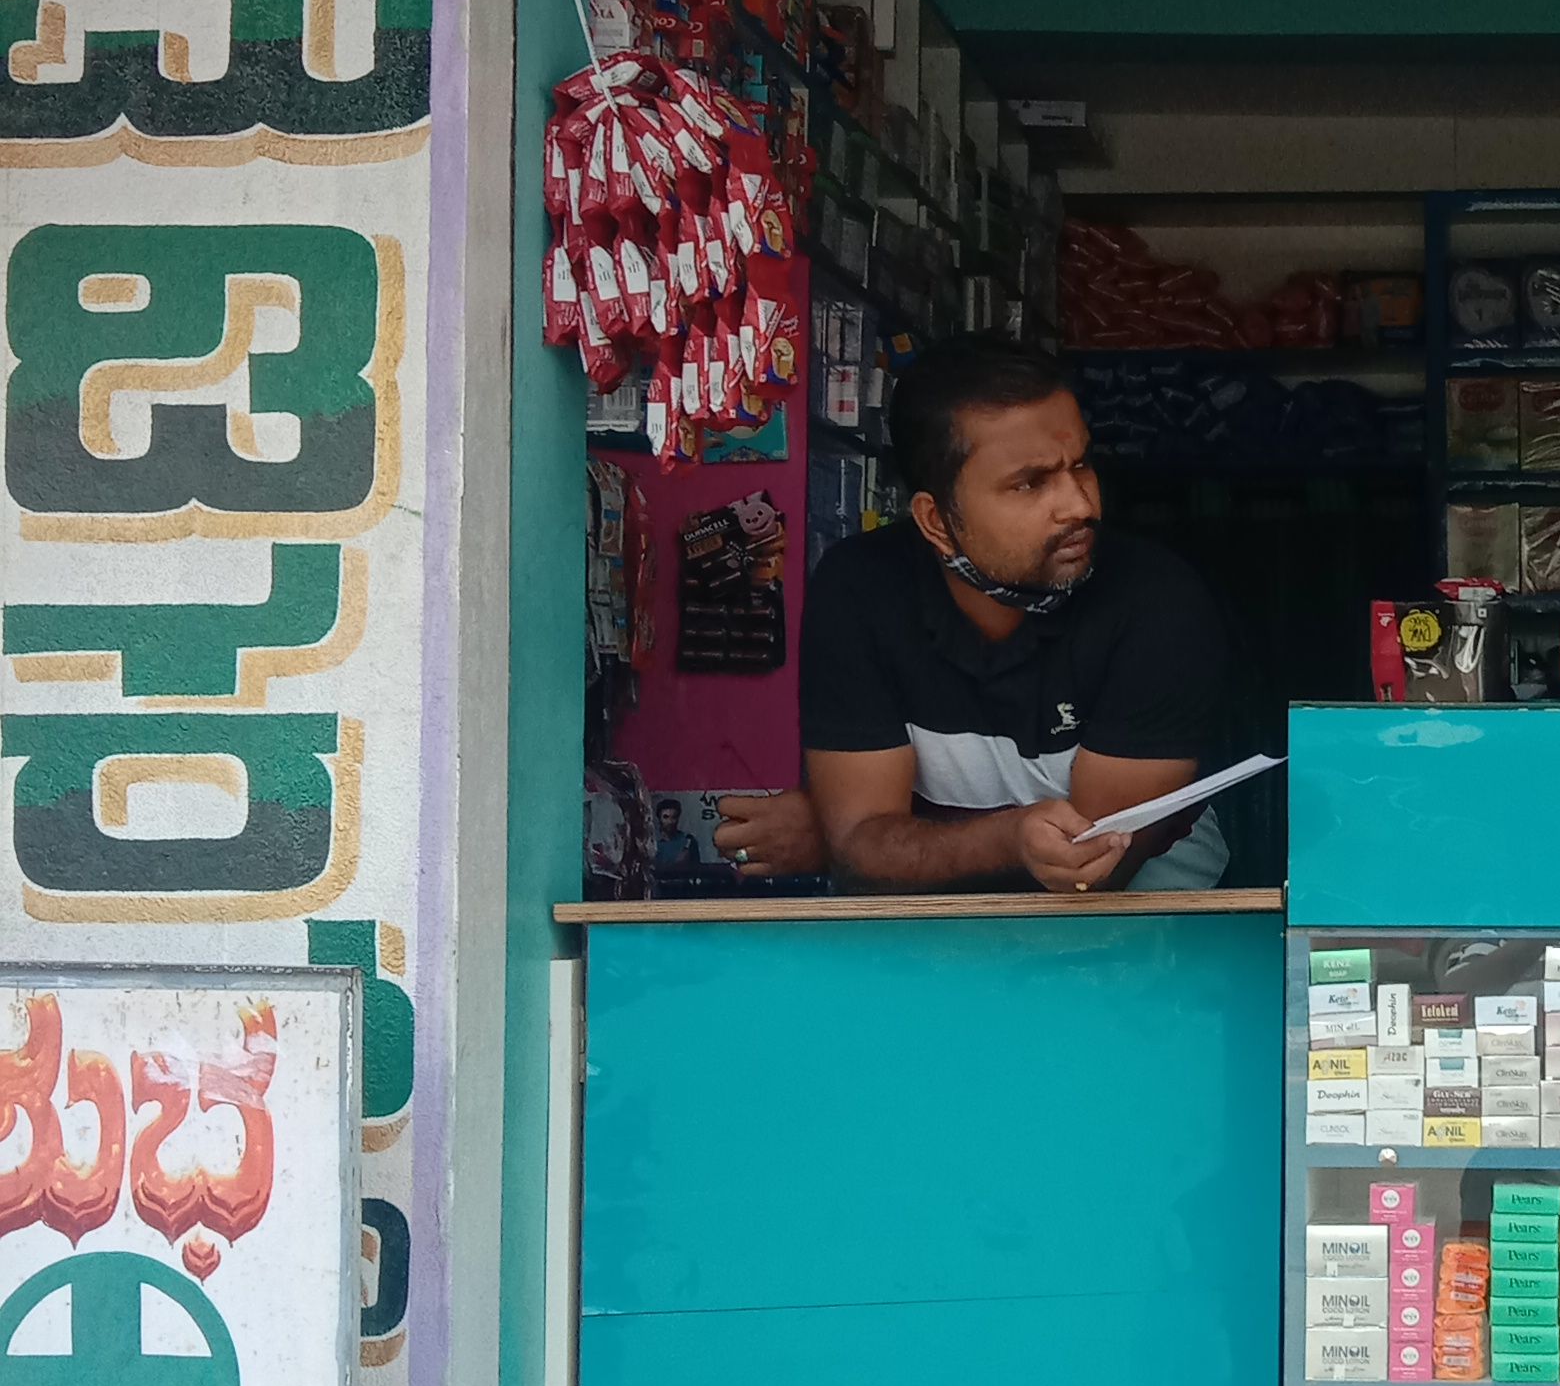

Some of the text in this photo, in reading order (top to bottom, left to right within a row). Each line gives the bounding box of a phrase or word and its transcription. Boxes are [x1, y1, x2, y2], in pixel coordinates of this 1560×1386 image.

[1511, 1193, 1544, 1206] Pears
[1508, 1221, 1541, 1234] Pears
[1508, 1249, 1540, 1262] Pears
[1509, 1276, 1541, 1289] Pears
[1507, 1306, 1540, 1318] Pears
[1508, 1333, 1541, 1345] Pears
[1510, 1362, 1542, 1374] Pears
